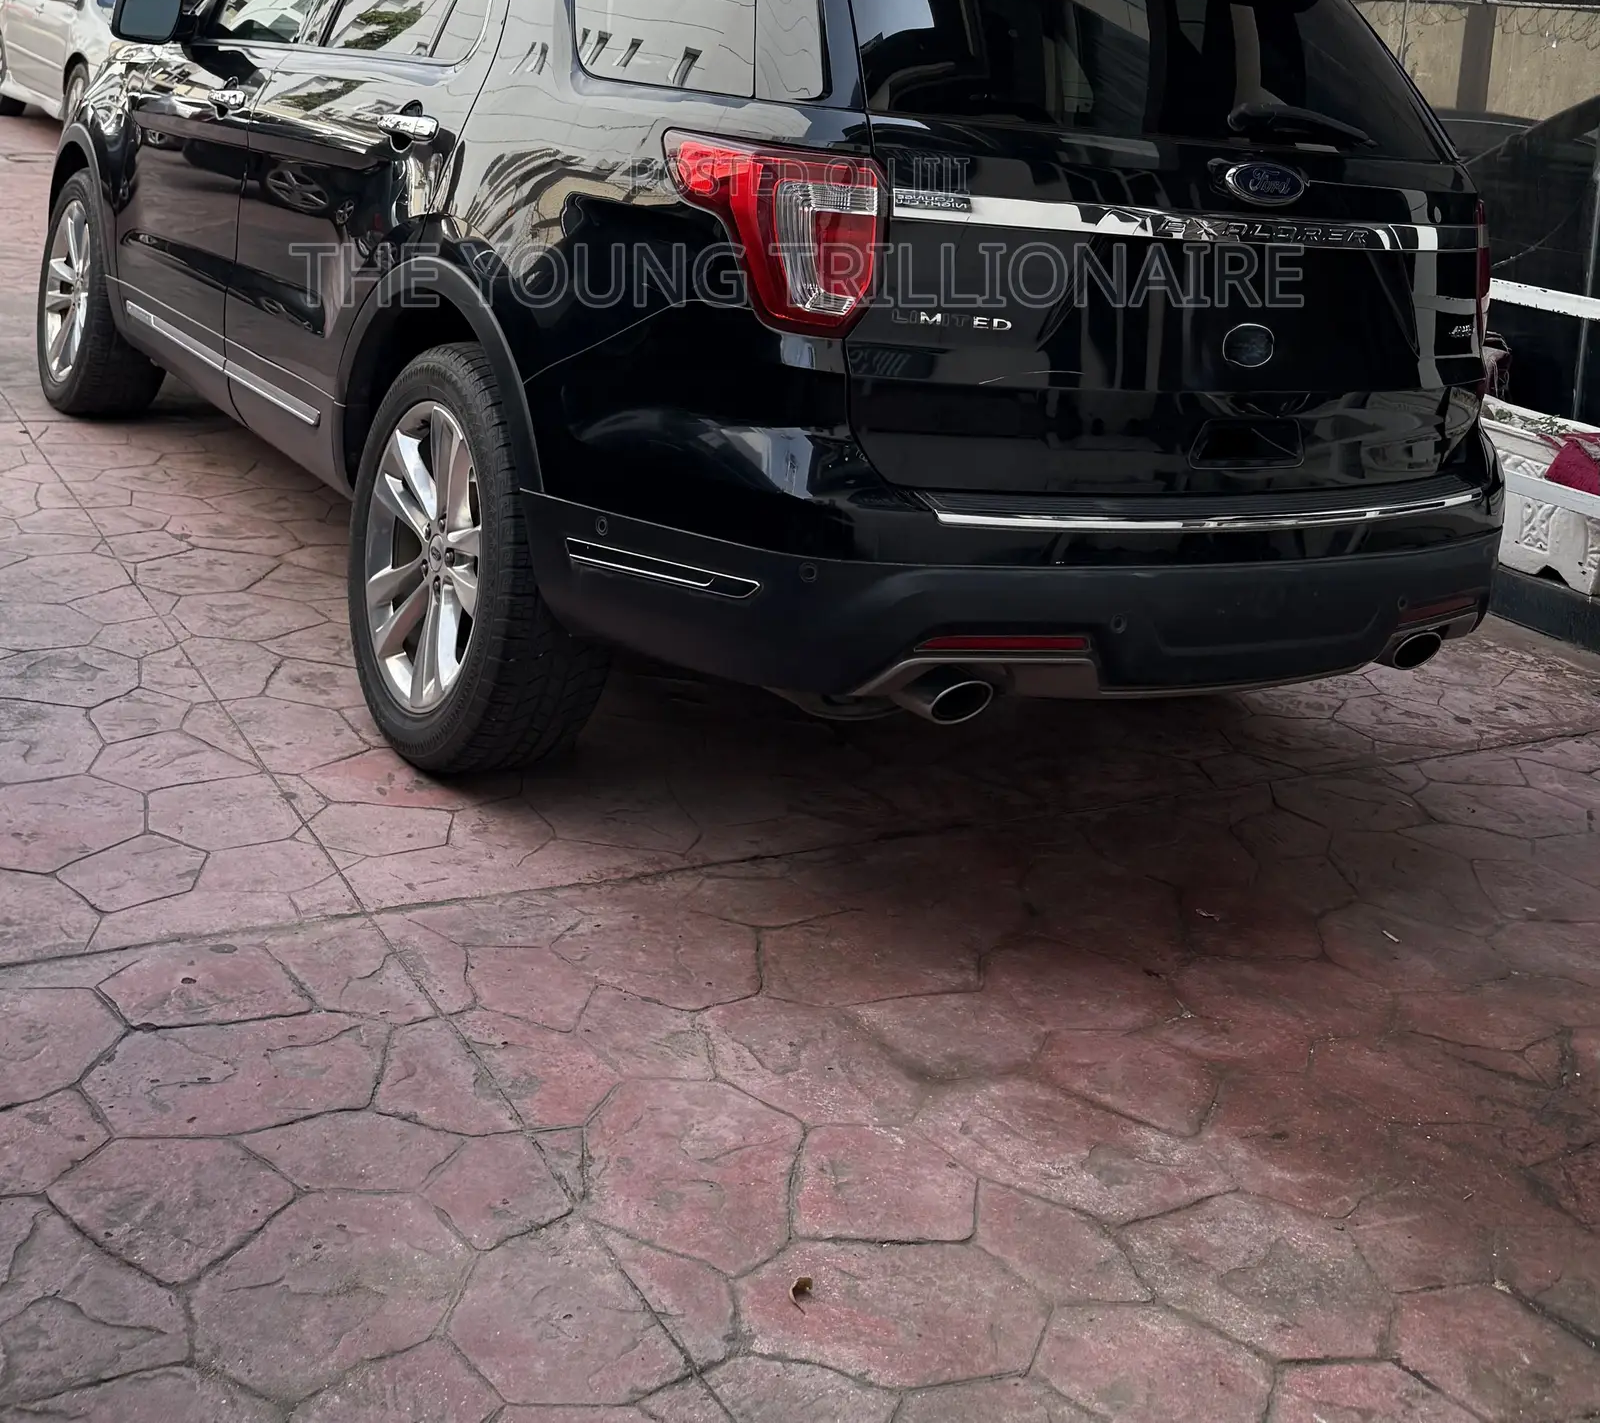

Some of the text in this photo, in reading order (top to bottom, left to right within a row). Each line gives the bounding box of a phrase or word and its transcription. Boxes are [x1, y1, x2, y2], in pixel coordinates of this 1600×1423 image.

[1248, 170, 1292, 194] Ford
[1156, 218, 1370, 244] EXPLORER
[892, 308, 1012, 331] LIMITED
